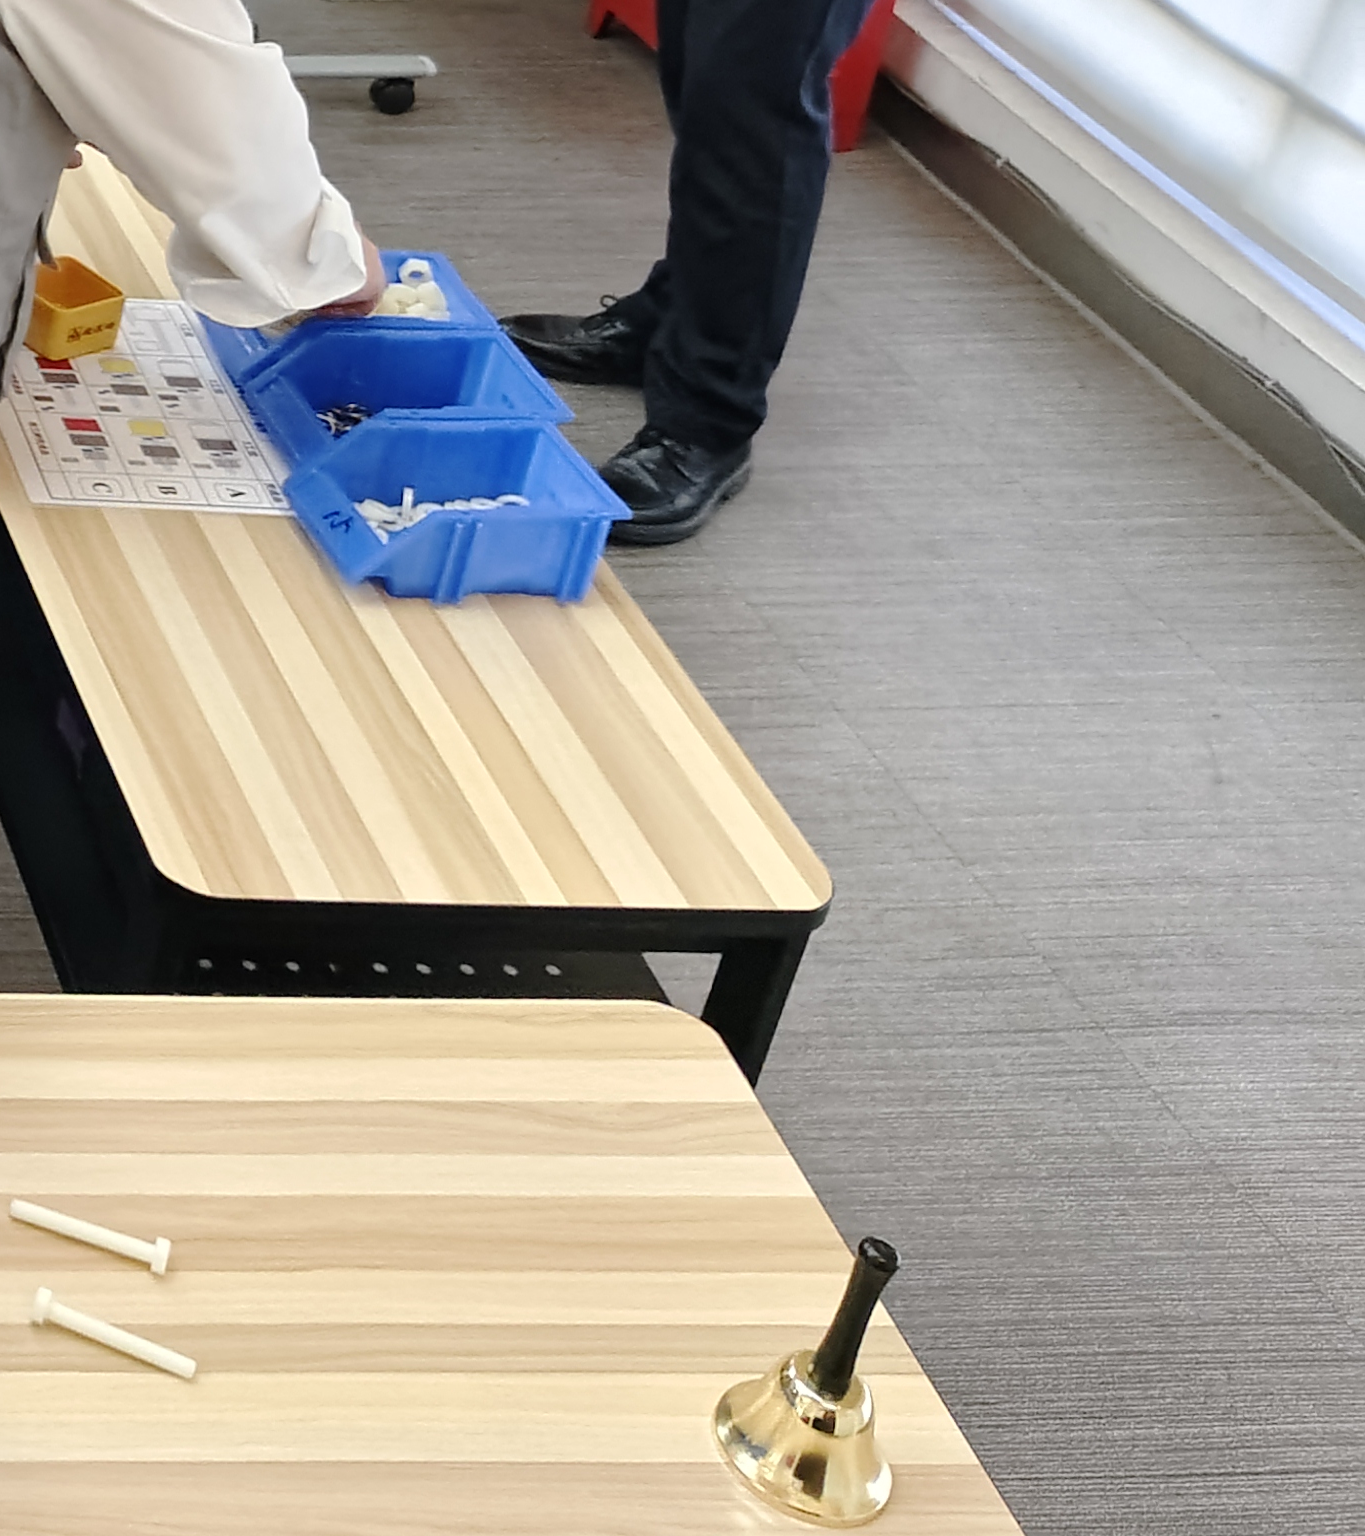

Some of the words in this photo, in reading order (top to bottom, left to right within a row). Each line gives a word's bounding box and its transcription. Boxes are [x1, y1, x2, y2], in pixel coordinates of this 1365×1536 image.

[92, 482, 112, 495] C
[157, 485, 178, 496] B
[229, 486, 247, 499] A
